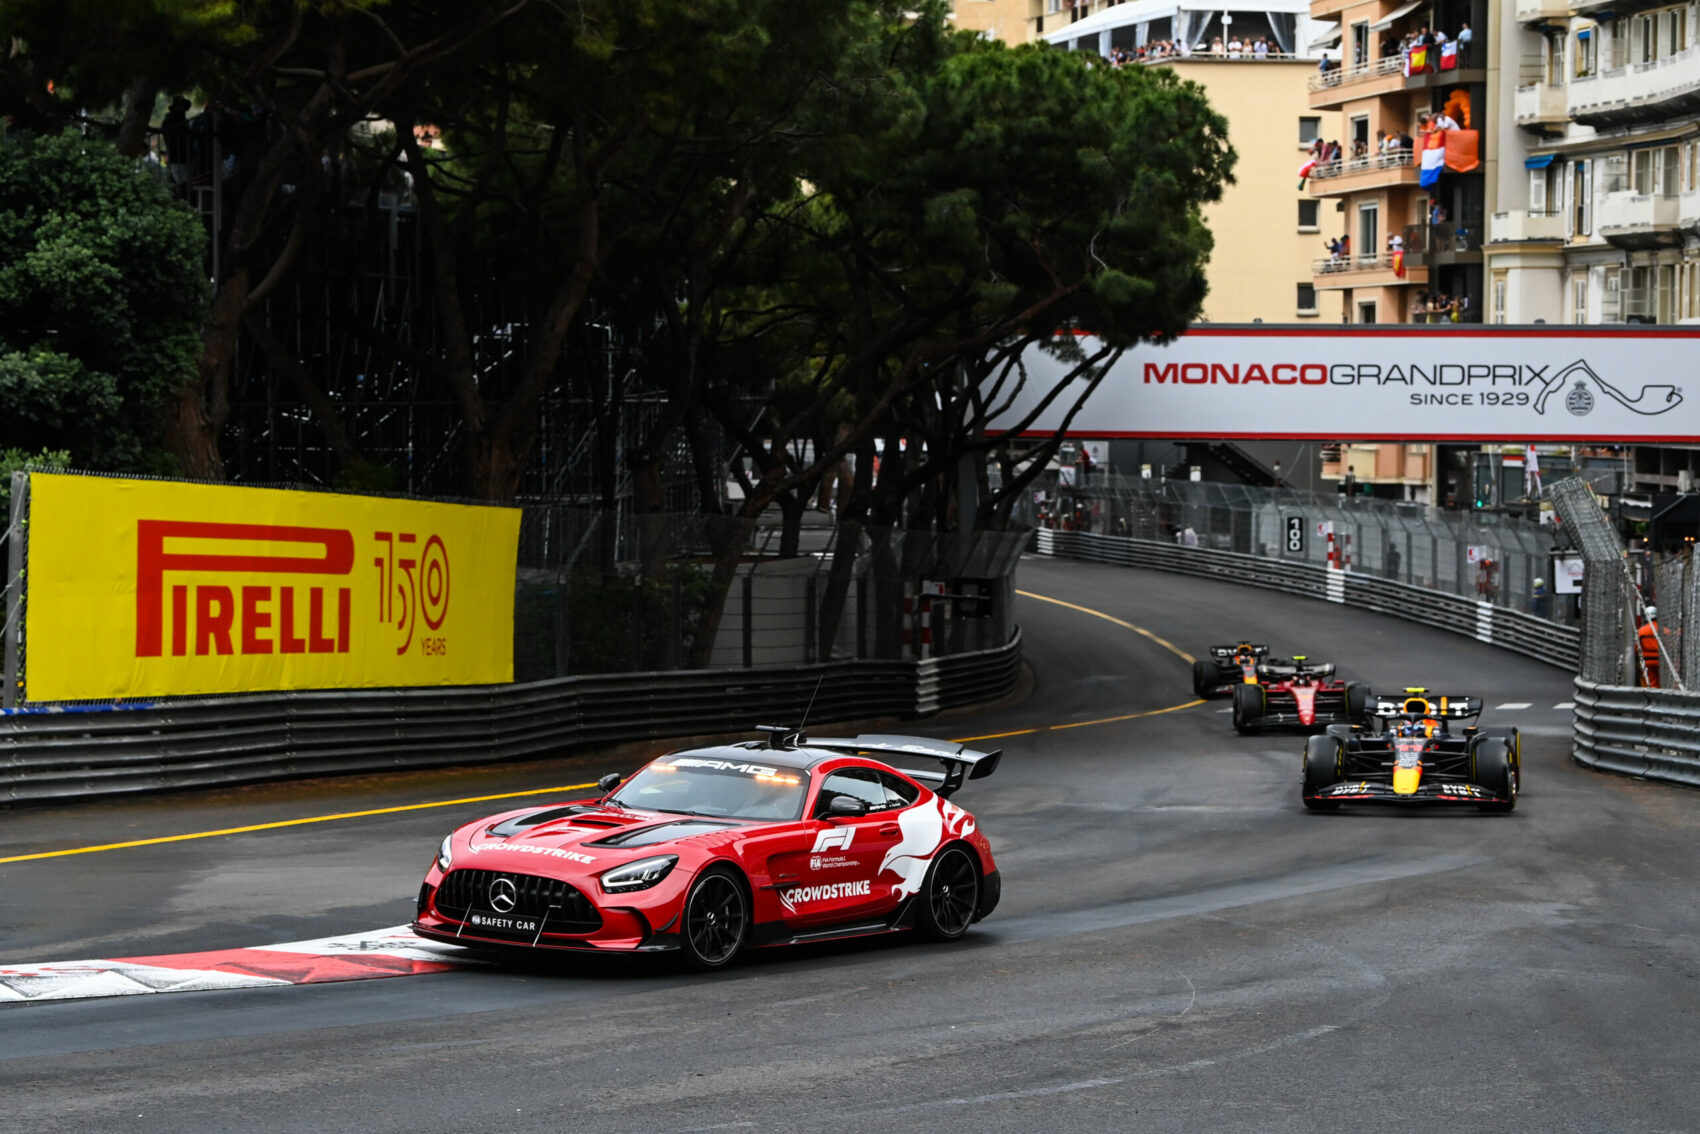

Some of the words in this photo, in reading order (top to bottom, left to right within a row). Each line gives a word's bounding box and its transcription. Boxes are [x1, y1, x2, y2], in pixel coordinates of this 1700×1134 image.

[1410, 393, 1473, 405] SINCE
[1479, 392, 1530, 406] 1929
[1289, 518, 1301, 551] 100
[135, 519, 355, 657] PIRELLI
[374, 531, 450, 656] 150
[420, 637, 447, 656] YEARS
[699, 760, 778, 777] AMG
[810, 826, 857, 853] F1
[477, 843, 597, 864] CROWDSTRIKE
[785, 880, 871, 904] CROWDSTRIKE
[481, 917, 513, 928] SAFETY
[516, 920, 536, 930] CAR
